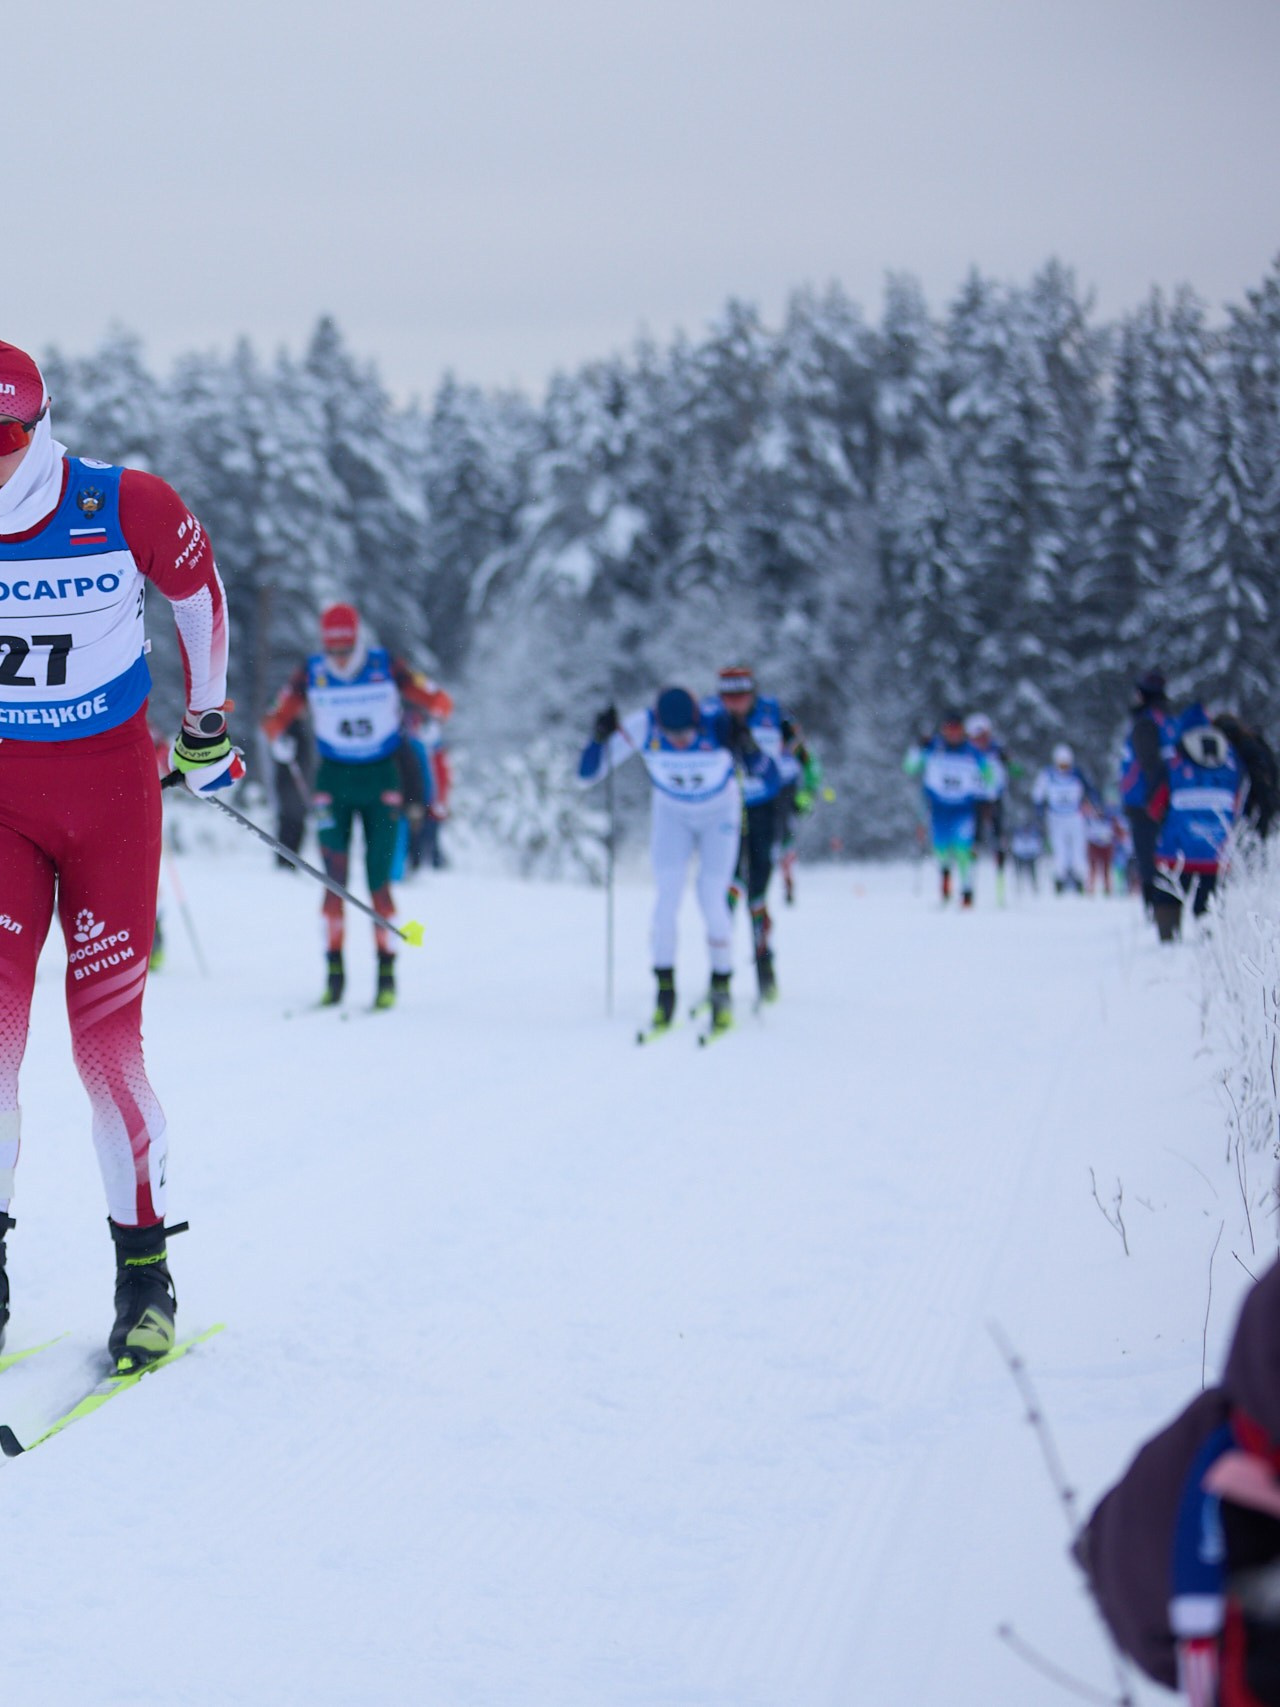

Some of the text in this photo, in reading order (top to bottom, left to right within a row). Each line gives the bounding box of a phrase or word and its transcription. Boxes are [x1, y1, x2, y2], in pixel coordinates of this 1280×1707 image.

[175, 513, 201, 569] ЛУКОЙ
[69, 930, 130, 963] ФОСАГРО
[74, 946, 135, 980] BIVIUM
